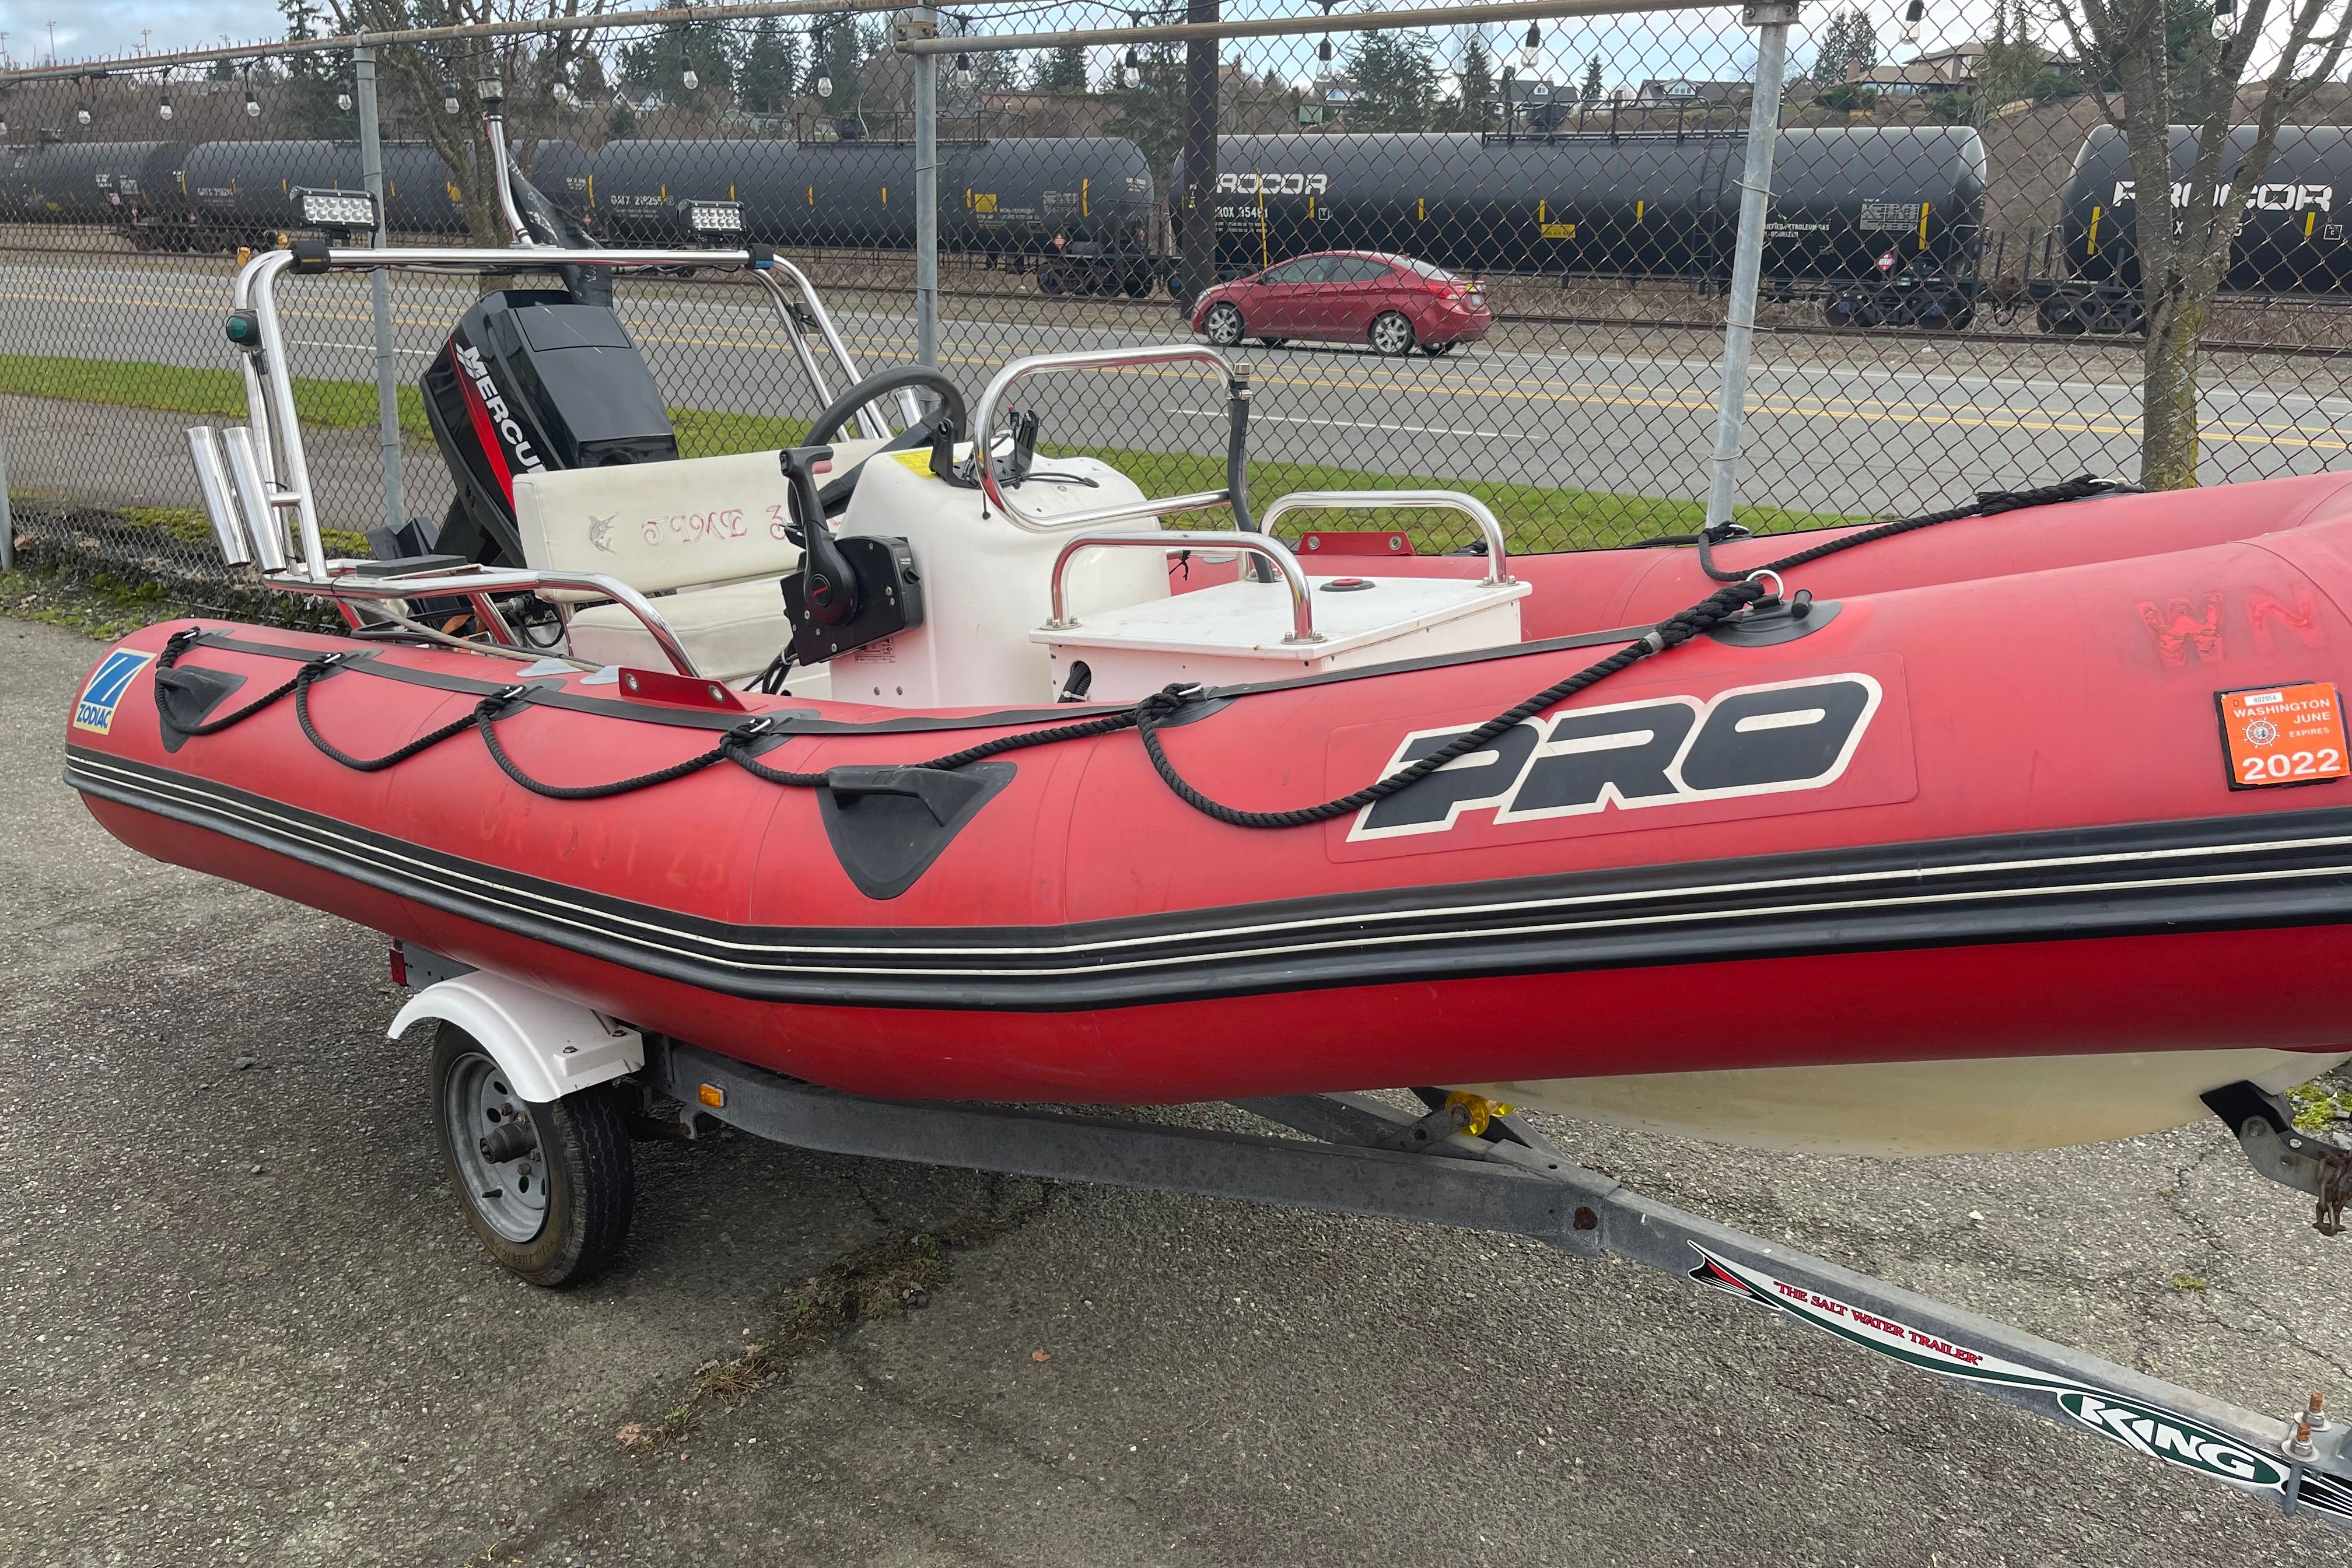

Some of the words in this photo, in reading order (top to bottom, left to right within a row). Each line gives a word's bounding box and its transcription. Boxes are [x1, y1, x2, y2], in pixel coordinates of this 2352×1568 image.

[1216, 173, 1328, 195] ROCOR
[76, 703, 112, 729] ZODIAC
[2234, 698, 2330, 718] WASHINGTON
[2293, 711, 2331, 724] JUNE
[2288, 727, 2330, 738] EXPIRES
[1345, 672, 1883, 842] PRO
[2242, 748, 2341, 780] 2022
[1811, 1296, 1848, 1317] SALT
[1851, 1310, 1905, 1338] WATER
[2080, 1396, 2255, 1479] KING
